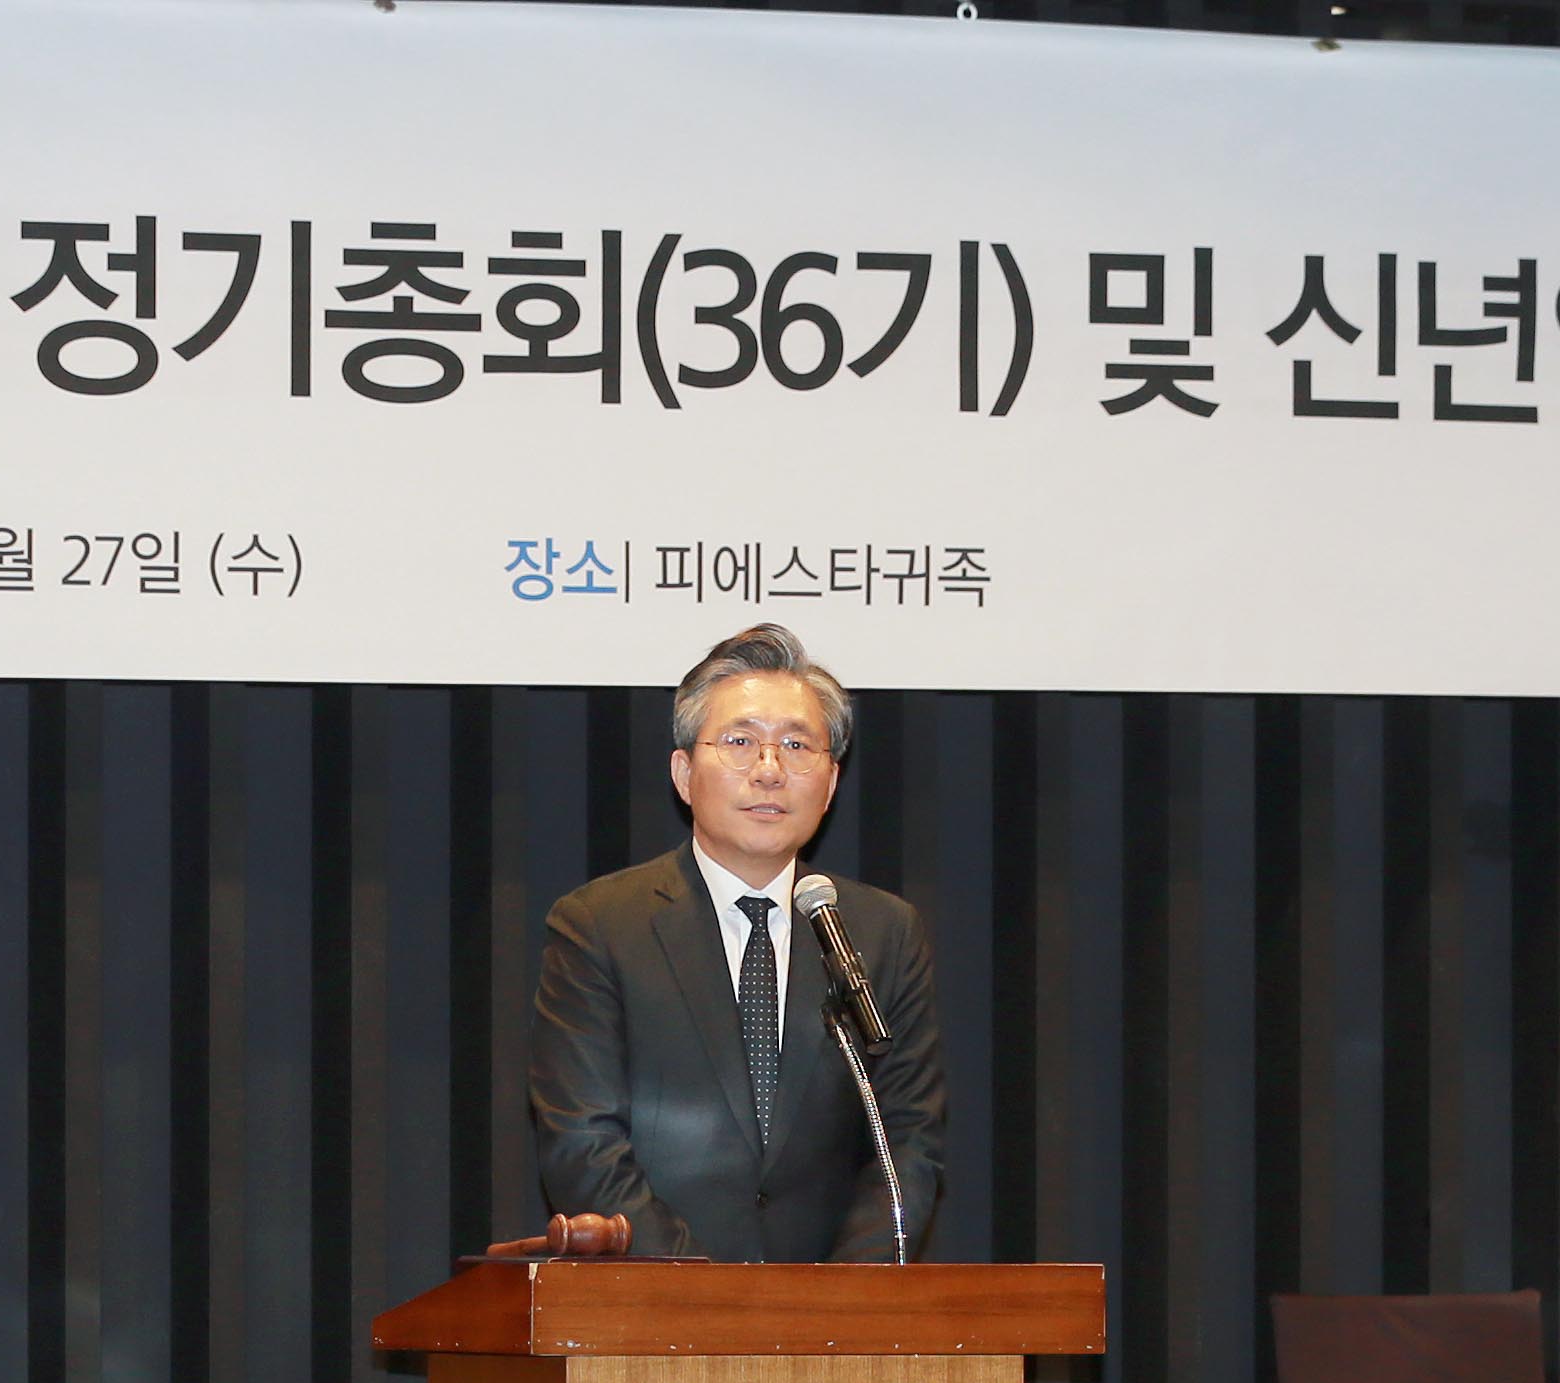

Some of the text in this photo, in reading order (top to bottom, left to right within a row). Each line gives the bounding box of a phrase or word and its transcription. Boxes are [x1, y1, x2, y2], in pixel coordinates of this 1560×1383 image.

[10, 214, 1034, 417] 정기총회(36기)
[1088, 247, 1220, 418] 및
[60, 531, 182, 595] 27일
[209, 532, 303, 598] (수)
[654, 541, 992, 608] 피에스타귀족
